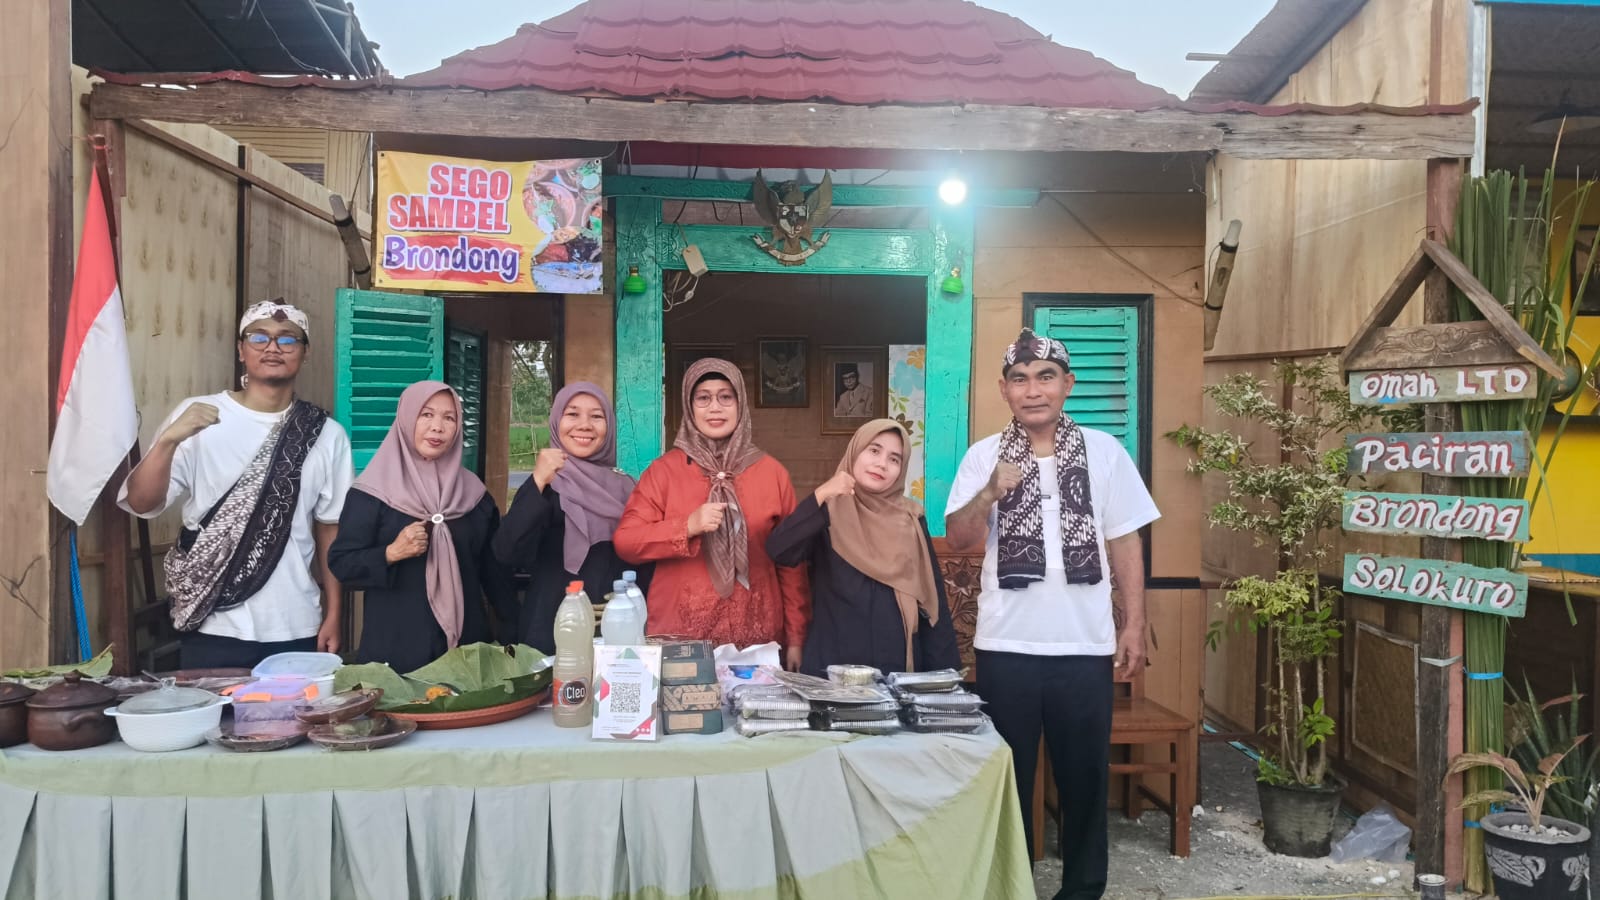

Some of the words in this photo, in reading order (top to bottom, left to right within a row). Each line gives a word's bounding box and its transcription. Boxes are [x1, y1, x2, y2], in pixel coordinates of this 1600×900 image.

[429, 164, 510, 202] SEGO
[388, 195, 509, 233] SAMBEL
[384, 235, 519, 282] Brondong
[1456, 366, 1530, 395] LTD
[1354, 435, 1515, 475] Paciran
[1349, 495, 1524, 540] Brondong
[566, 686, 586, 699] Cleo
